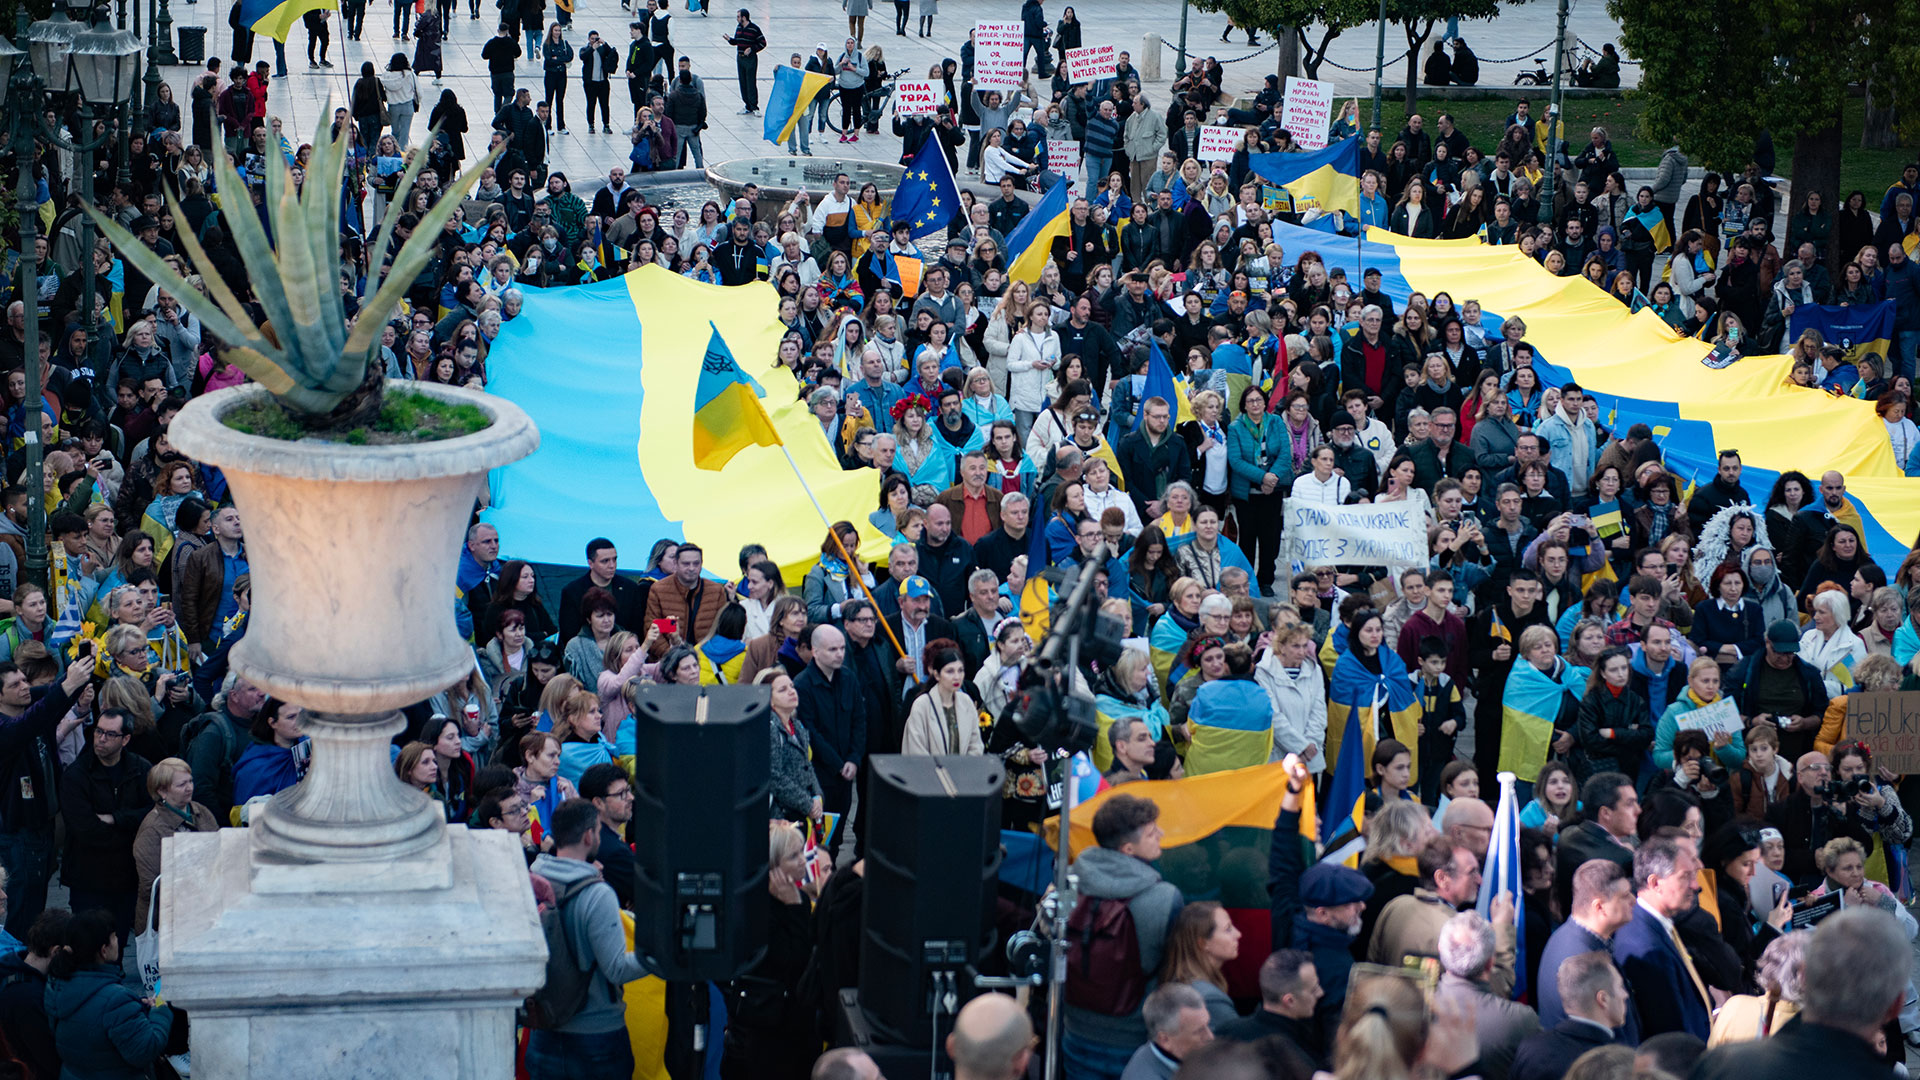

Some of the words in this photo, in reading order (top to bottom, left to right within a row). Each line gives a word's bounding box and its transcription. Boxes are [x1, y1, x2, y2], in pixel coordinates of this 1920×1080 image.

[1071, 58, 1090, 68] UNITE
[899, 83, 931, 92] ΟΠΛΑ
[1295, 508, 1331, 527] STAND
[1361, 510, 1410, 529] UKRAINE
